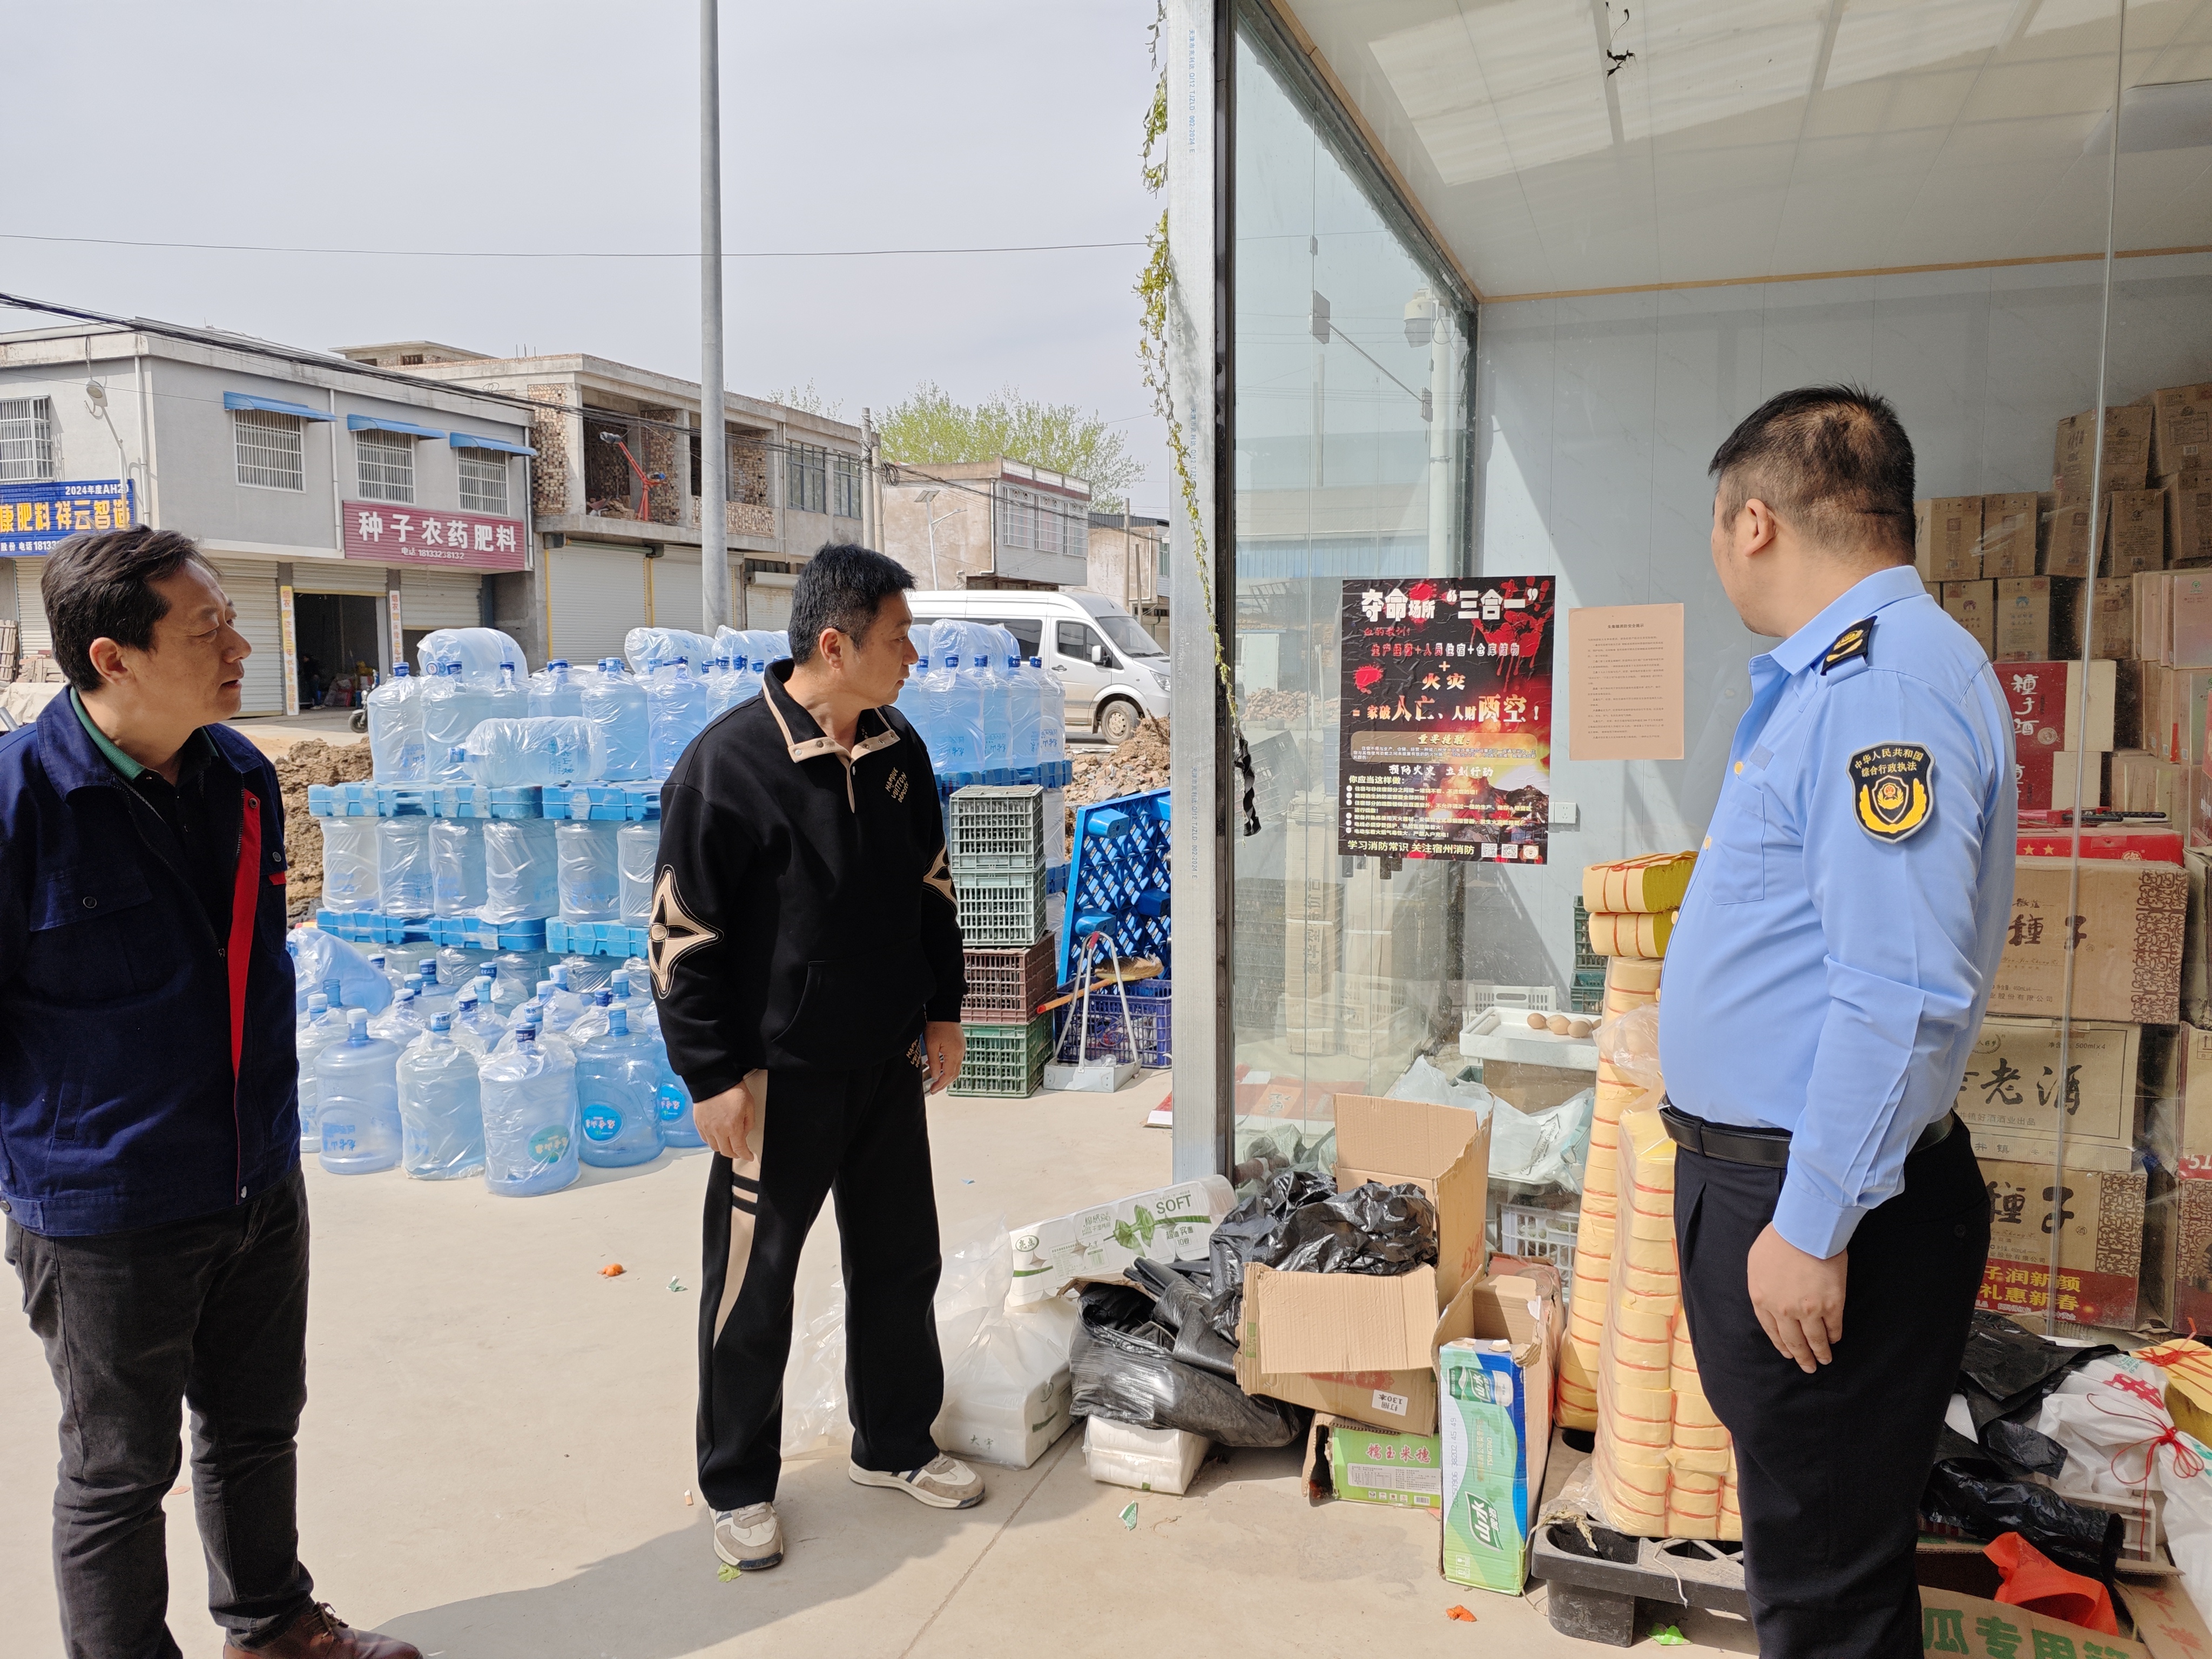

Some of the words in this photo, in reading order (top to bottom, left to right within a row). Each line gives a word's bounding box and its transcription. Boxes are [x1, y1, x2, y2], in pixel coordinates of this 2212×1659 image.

[358, 511, 517, 553] 种子农药肥料
[1421, 672, 1467, 691] 火灾
[1854, 747, 1924, 769] 中华人民共和国
[1388, 764, 1436, 776] 预防火灾
[1445, 765, 1494, 778] 立刻行动
[1861, 760, 1917, 778] 综合行政执法
[891, 771, 907, 799] VUITTON
[1347, 840, 1409, 853] 学习消防常识
[1411, 842, 1475, 855] 关注宿州消防
[1156, 1194, 1191, 1214] SOFT
[1472, 1373, 1486, 1398] 山水
[1378, 1393, 1403, 1405] 130本
[1365, 1443, 1431, 1464] 糯玉米穗
[1471, 1498, 1492, 1542] 山水
[1487, 1507, 1500, 1532] 啤酒
